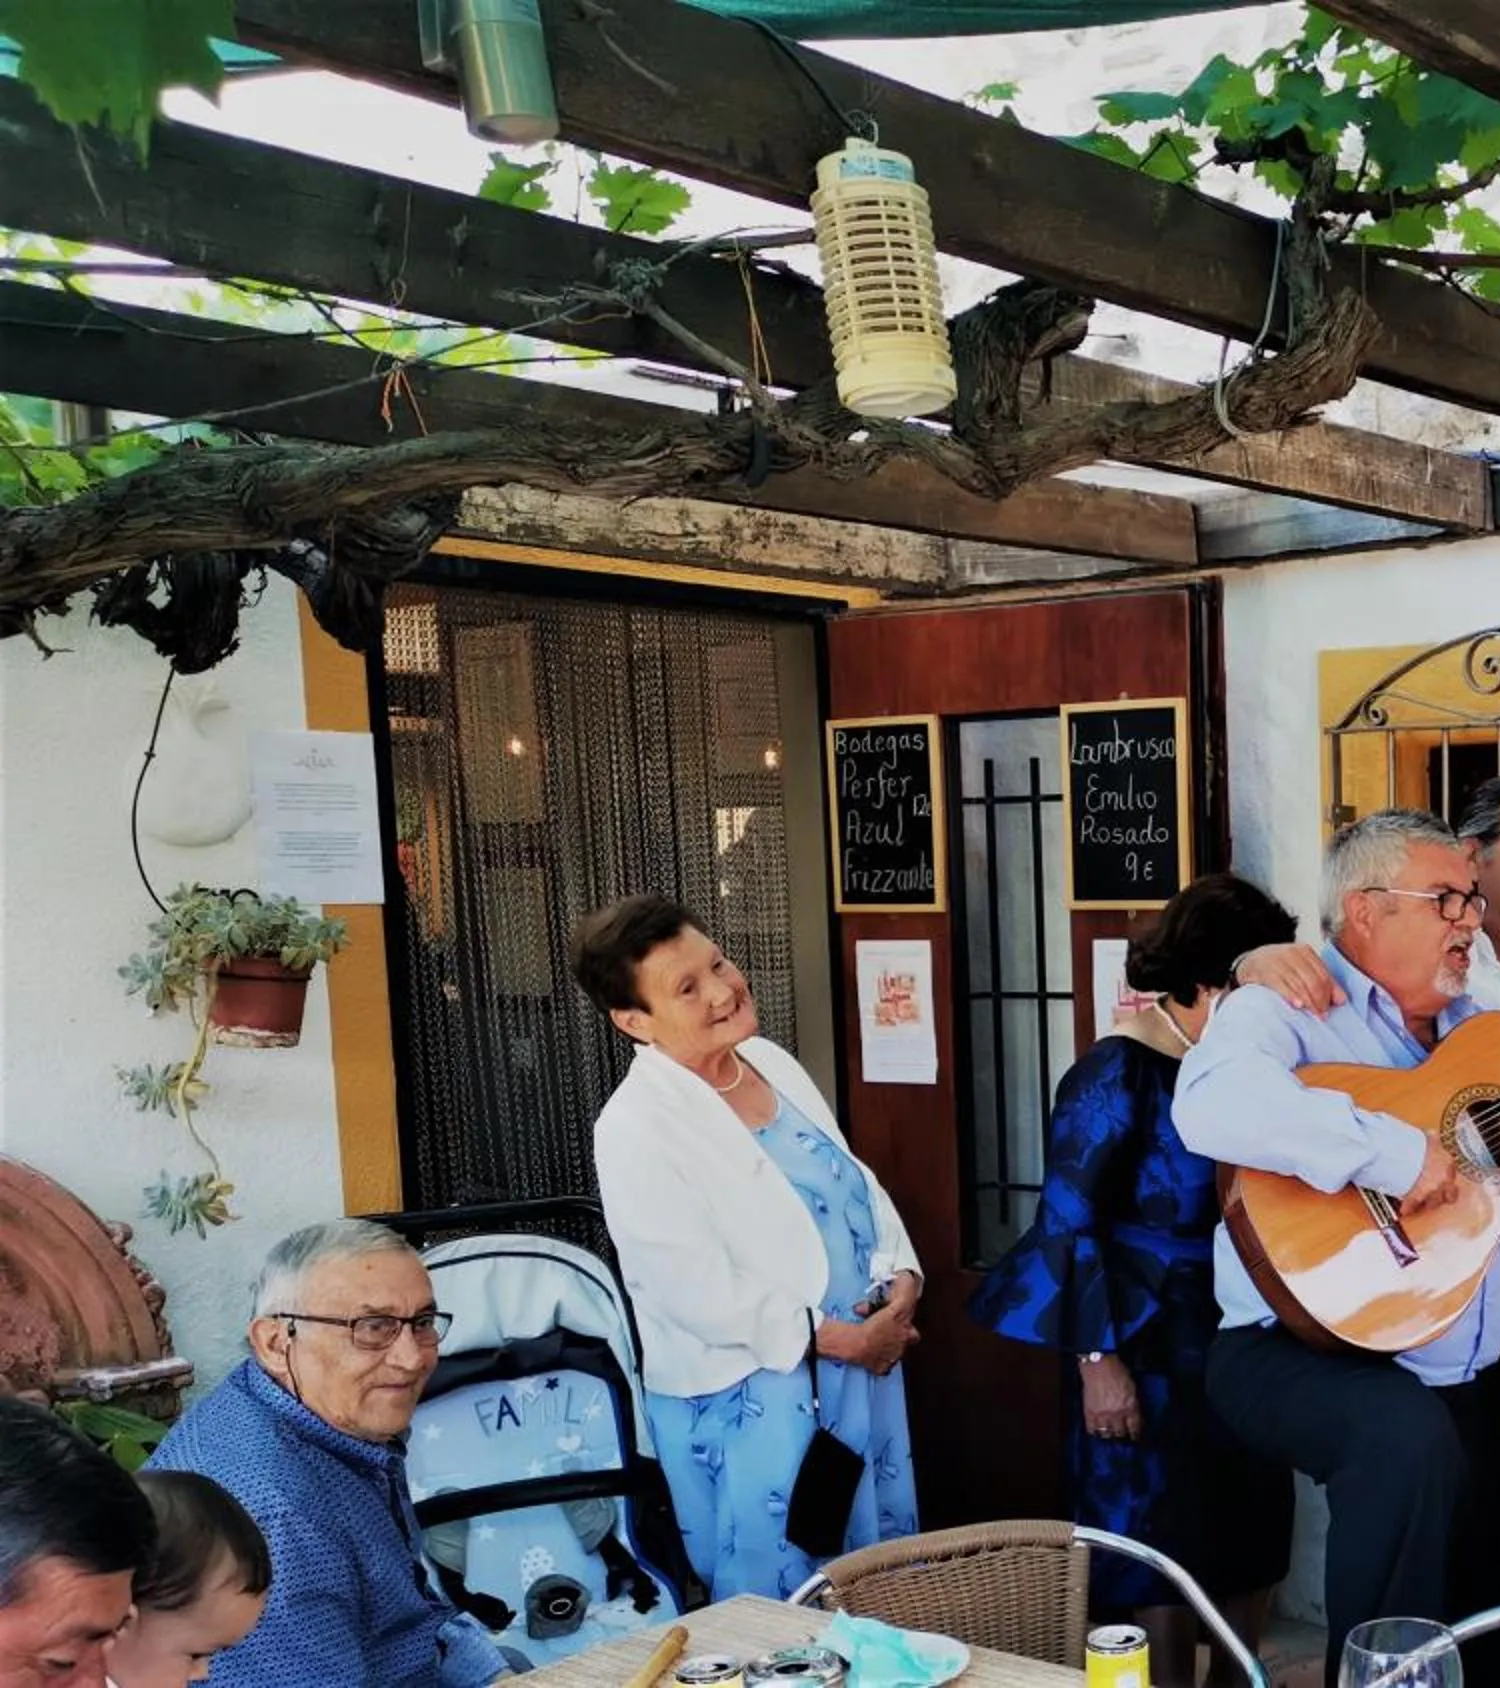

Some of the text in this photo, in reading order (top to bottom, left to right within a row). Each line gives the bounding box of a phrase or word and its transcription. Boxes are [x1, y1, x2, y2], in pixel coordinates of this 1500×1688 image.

[835, 729, 925, 770] Bodegas
[1085, 772, 1157, 812] Emilio
[845, 803, 905, 847] Azul
[1081, 814, 1169, 844] Rosado
